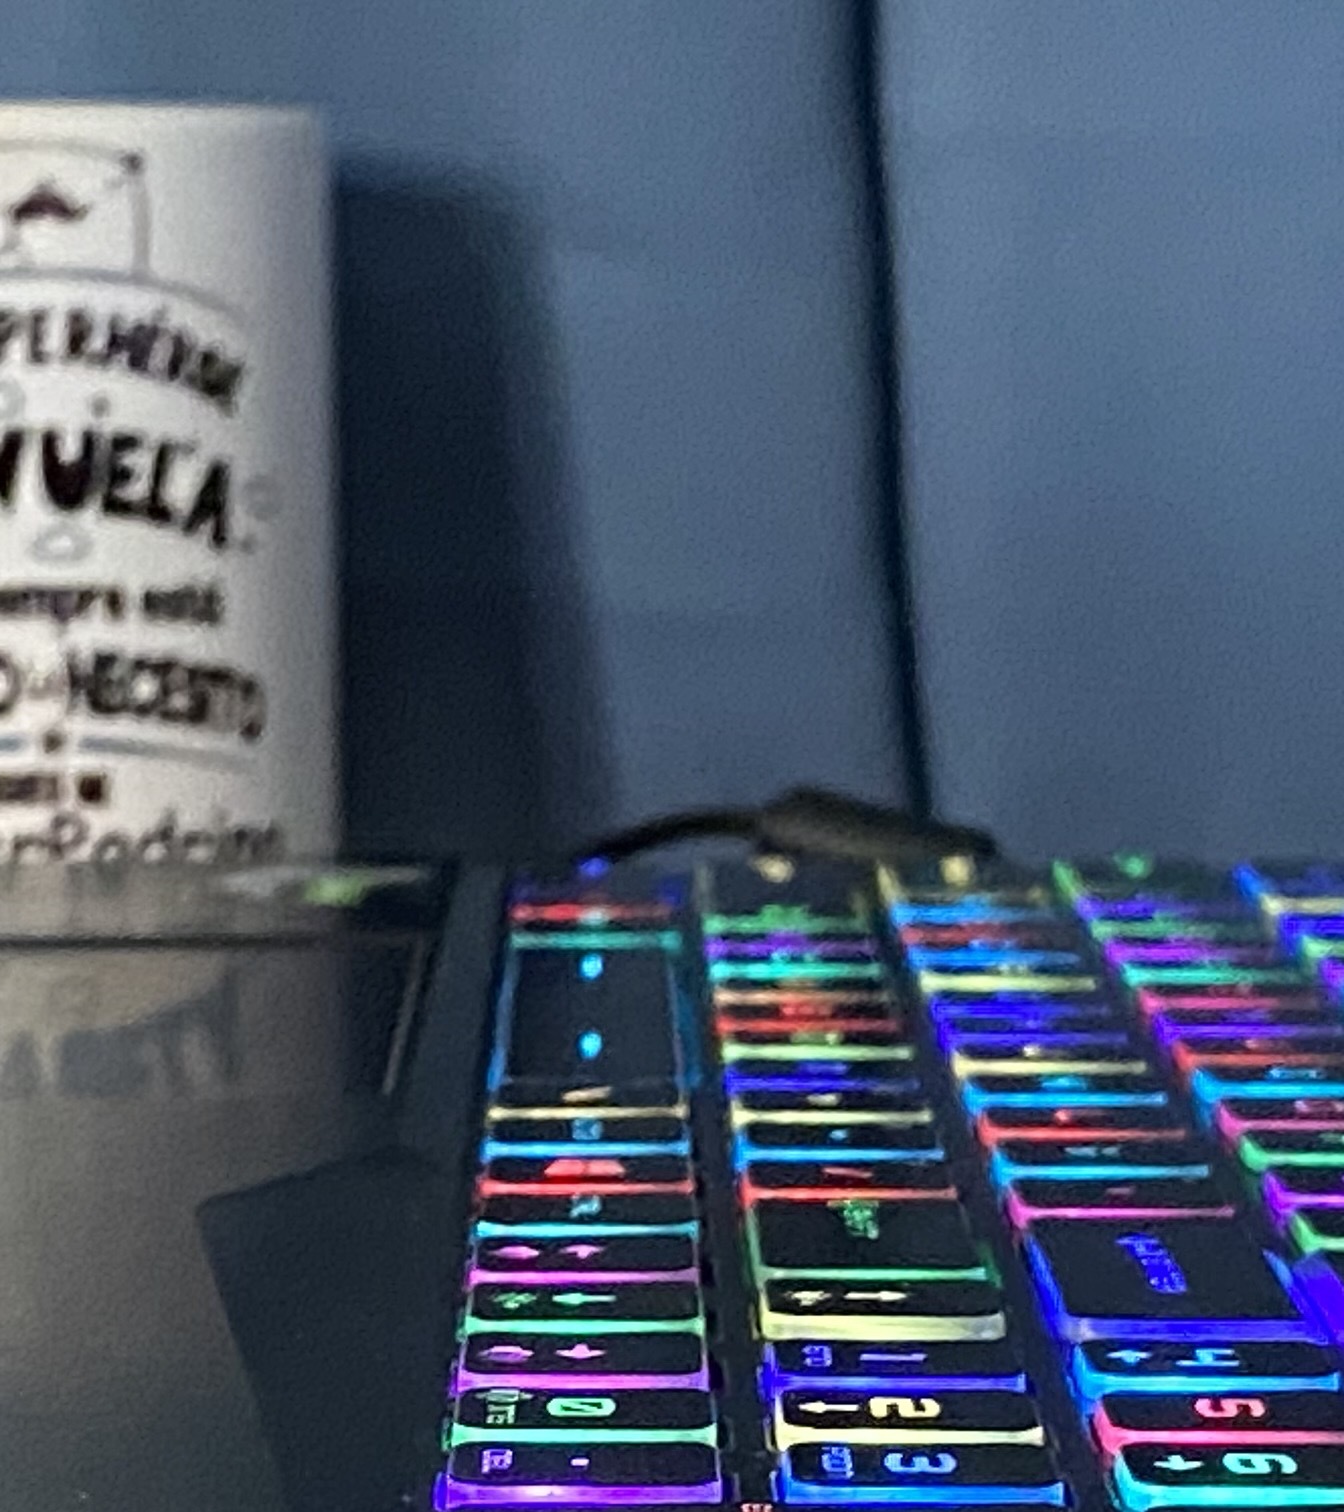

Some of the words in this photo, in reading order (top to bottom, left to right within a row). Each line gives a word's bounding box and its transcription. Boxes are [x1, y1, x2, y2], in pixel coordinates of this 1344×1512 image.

[1176, 1348, 1240, 1366] 4
[870, 1397, 940, 1419] 2
[1194, 1397, 1265, 1418] 5
[883, 1452, 956, 1475] 3
[1222, 1452, 1297, 1475] 6
